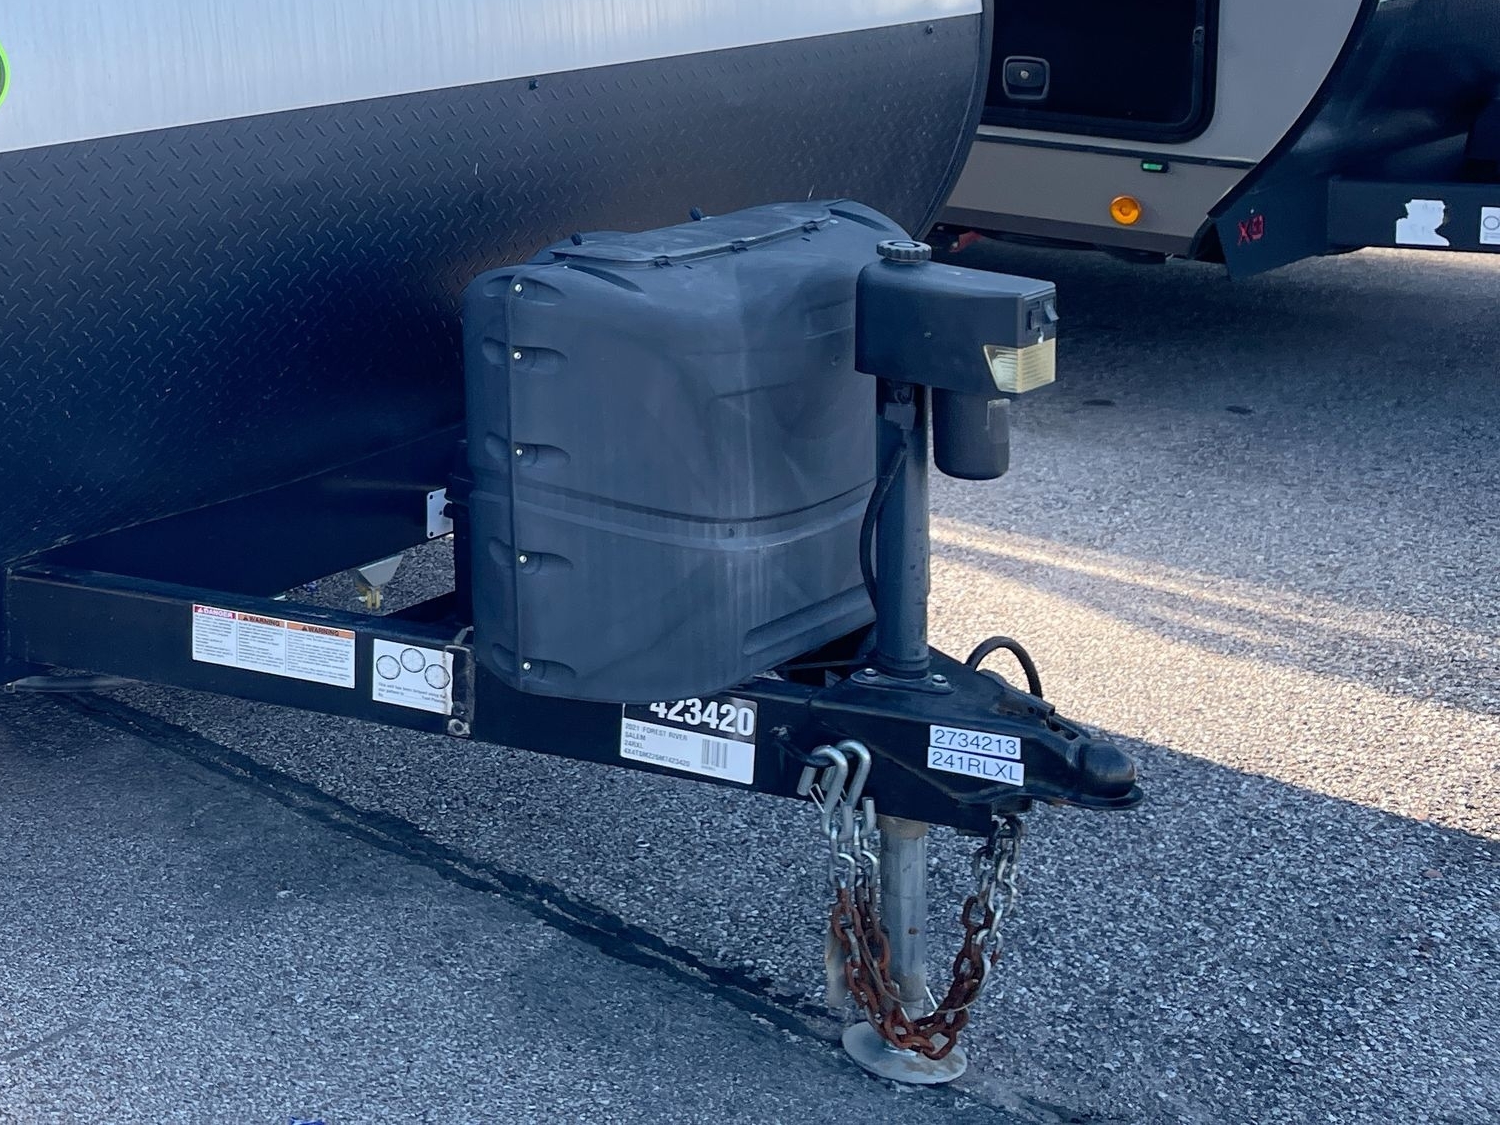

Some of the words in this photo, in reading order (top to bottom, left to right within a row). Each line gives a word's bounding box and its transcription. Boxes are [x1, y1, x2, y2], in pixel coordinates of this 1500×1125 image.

[203, 608, 233, 620] DANGER
[248, 616, 280, 627] WARNING
[307, 626, 339, 637] WARNING
[650, 697, 755, 736] 423420
[642, 726, 667, 738] FOREST
[934, 729, 1017, 755] 2734213
[932, 751, 1020, 782] 241RLXL
